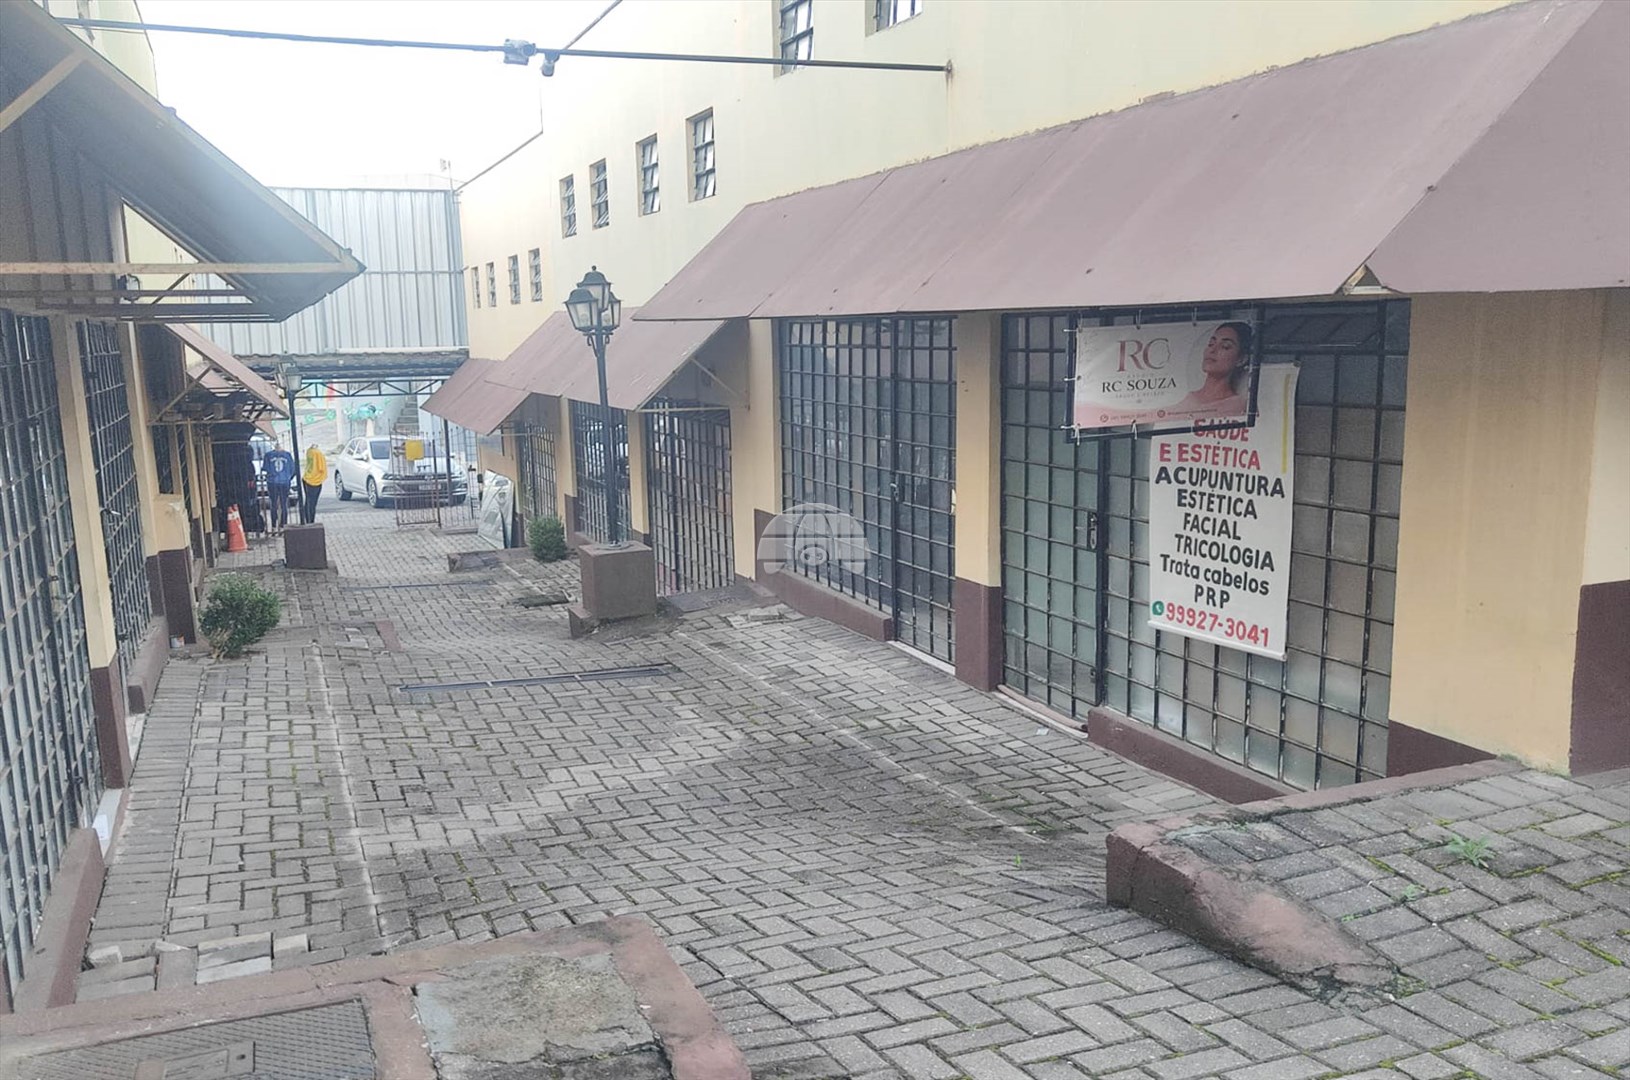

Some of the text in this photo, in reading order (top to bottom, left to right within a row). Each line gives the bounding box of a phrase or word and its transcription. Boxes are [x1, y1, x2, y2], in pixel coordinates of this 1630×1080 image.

[1117, 338, 1171, 373] RC
[1102, 377, 1177, 393] RC SOUZA
[1159, 441, 1261, 470] E ESTÉTICA
[1155, 466, 1285, 498] ACUPUNTURA
[1177, 488, 1257, 519] ESTÉTICA
[1183, 513, 1241, 540] FACIAL
[1175, 534, 1275, 571] TRICOLOGIA
[1160, 554, 1270, 595] Trata cabelos
[1194, 585, 1230, 608] PRP
[1166, 602, 1269, 647] 99927-3041
